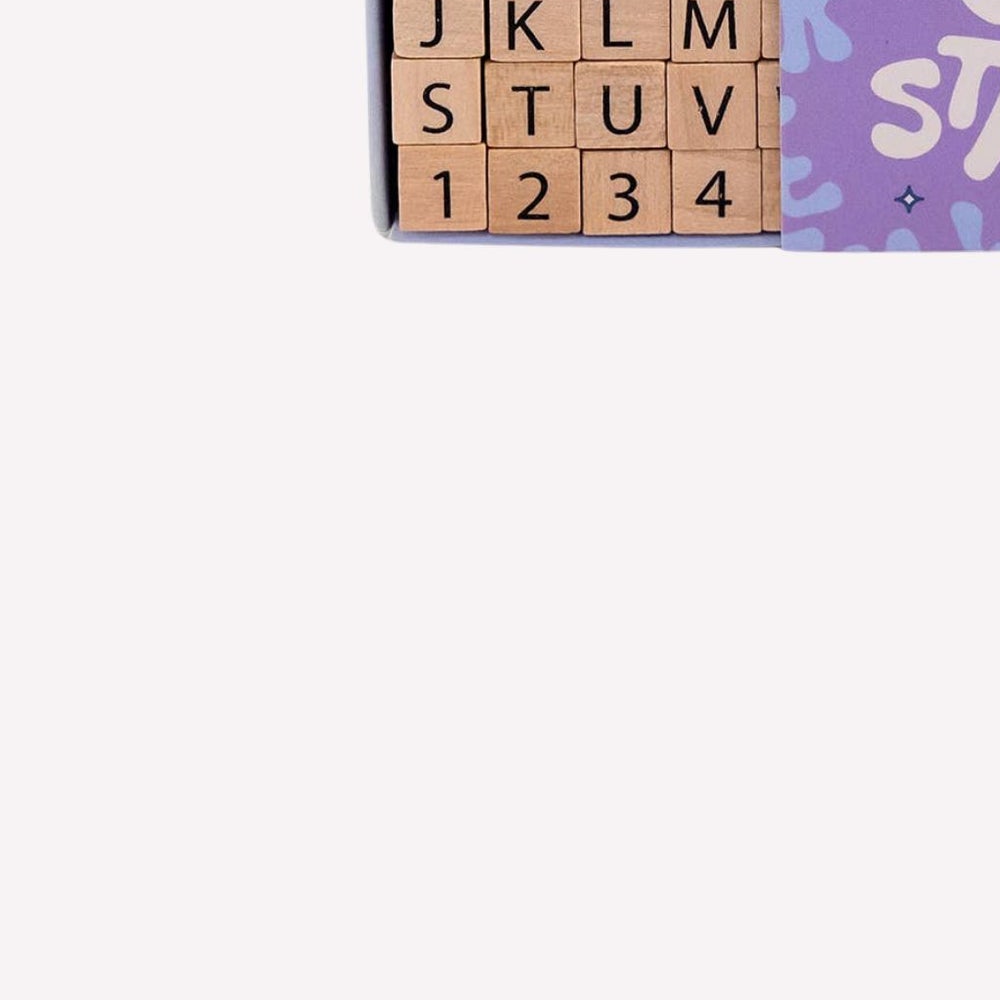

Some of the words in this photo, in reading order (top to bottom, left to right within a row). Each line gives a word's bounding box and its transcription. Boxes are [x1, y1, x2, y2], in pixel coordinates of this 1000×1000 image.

[508, 0, 545, 50] K
[422, 83, 454, 134] S
[511, 86, 550, 136] T
[603, 85, 642, 135] U
[692, 86, 734, 136] V
[434, 171, 451, 219] 1
[517, 172, 550, 221] 2
[608, 173, 639, 222] 3
[695, 171, 732, 218] 4
